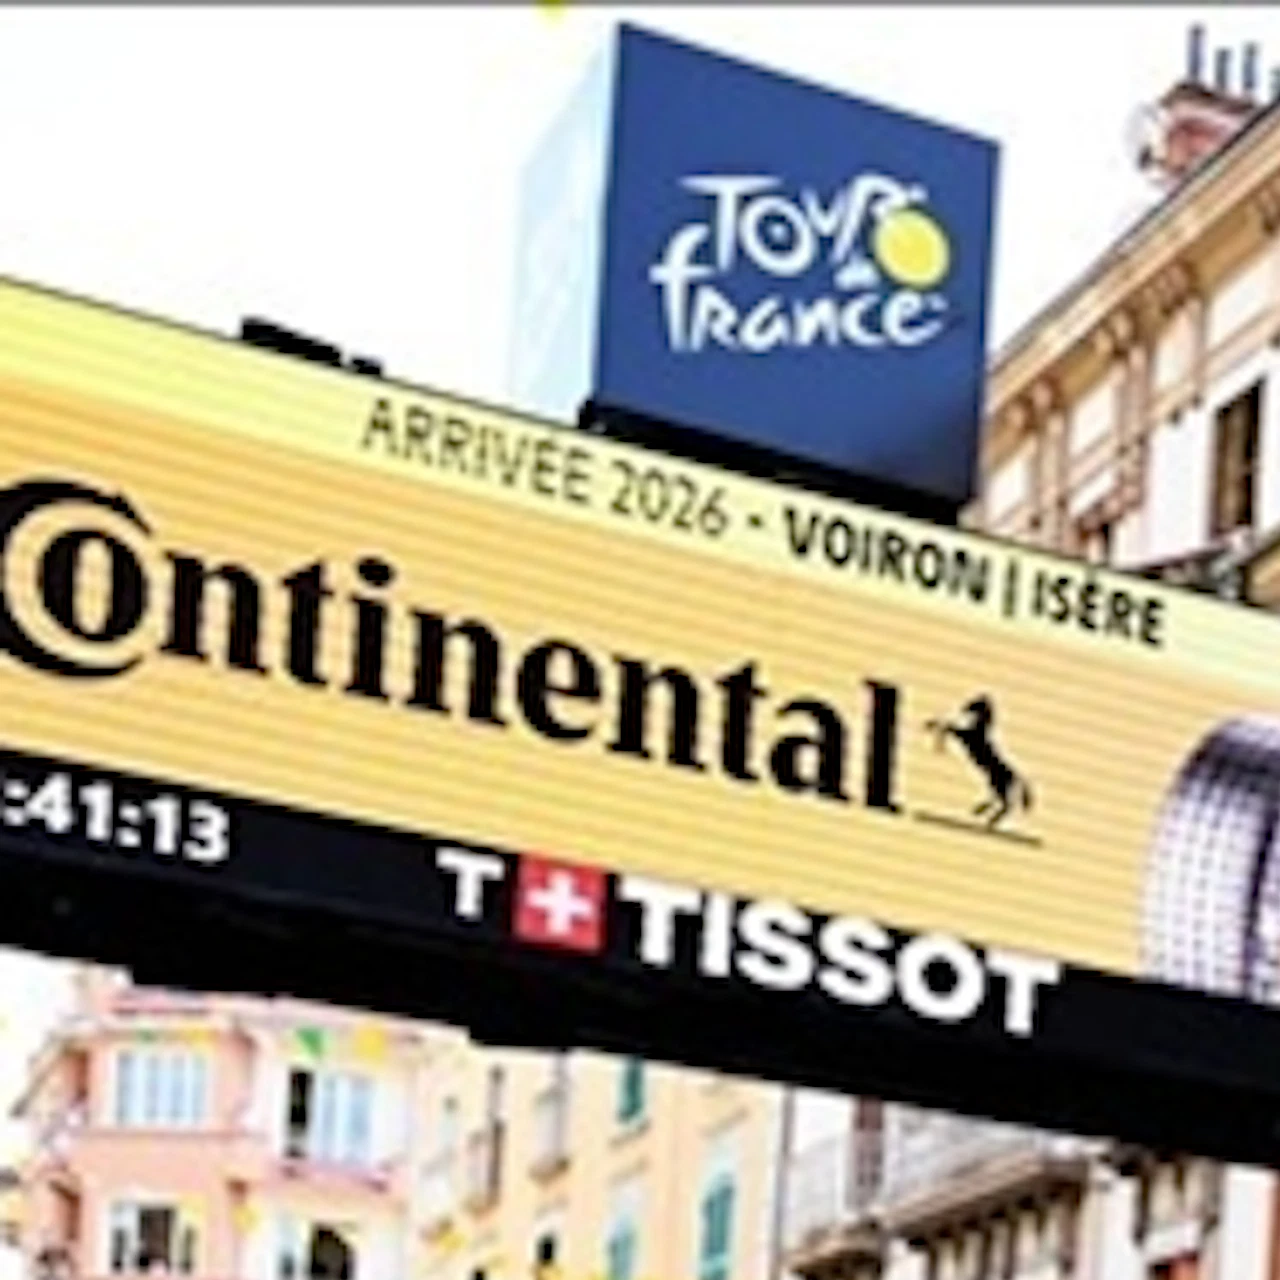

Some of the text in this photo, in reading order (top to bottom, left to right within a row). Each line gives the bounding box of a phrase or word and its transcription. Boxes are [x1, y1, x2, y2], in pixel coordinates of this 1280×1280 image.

[609, 457, 730, 538] 2026
[782, 503, 993, 605] VOIRON
[0, 476, 903, 815] Continental
[615, 874, 1060, 1037] TISSOT
